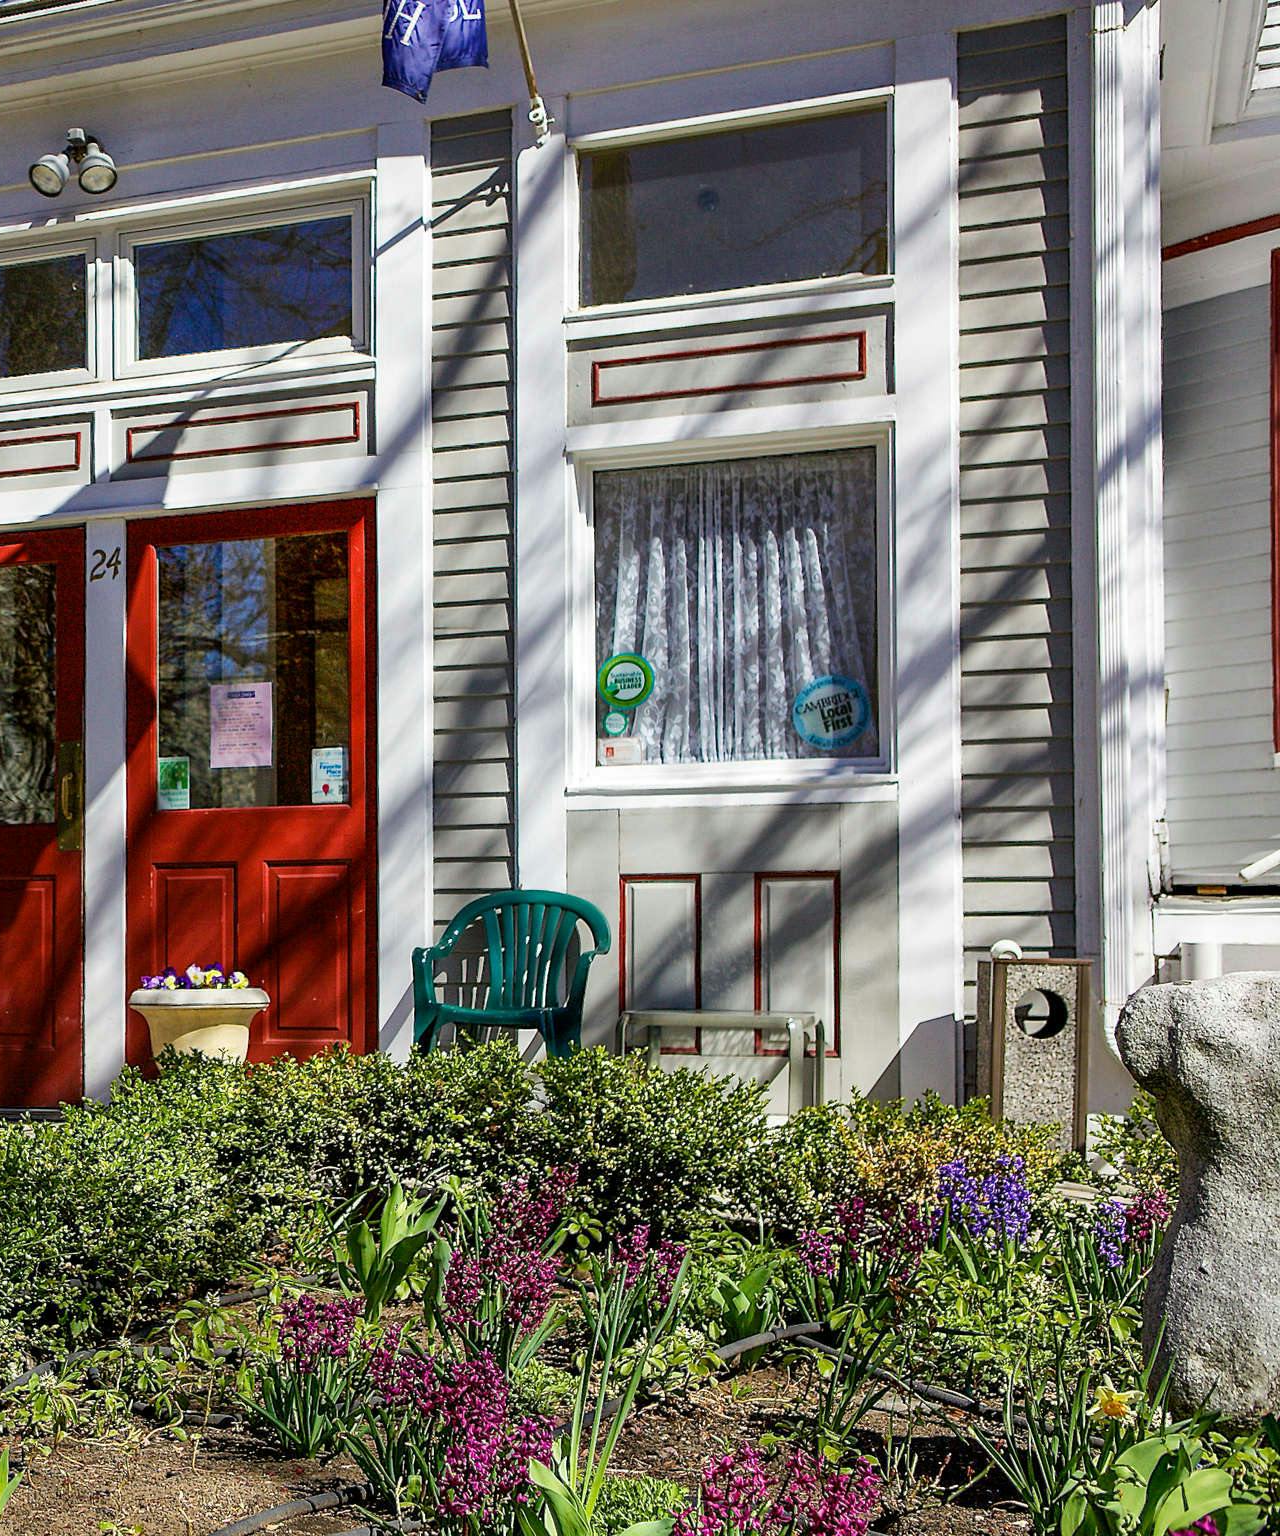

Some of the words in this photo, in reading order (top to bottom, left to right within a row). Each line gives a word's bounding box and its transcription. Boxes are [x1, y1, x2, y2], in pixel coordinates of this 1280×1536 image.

[90, 546, 121, 582] 24
[820, 700, 853, 721] Local
[823, 714, 853, 733] First
